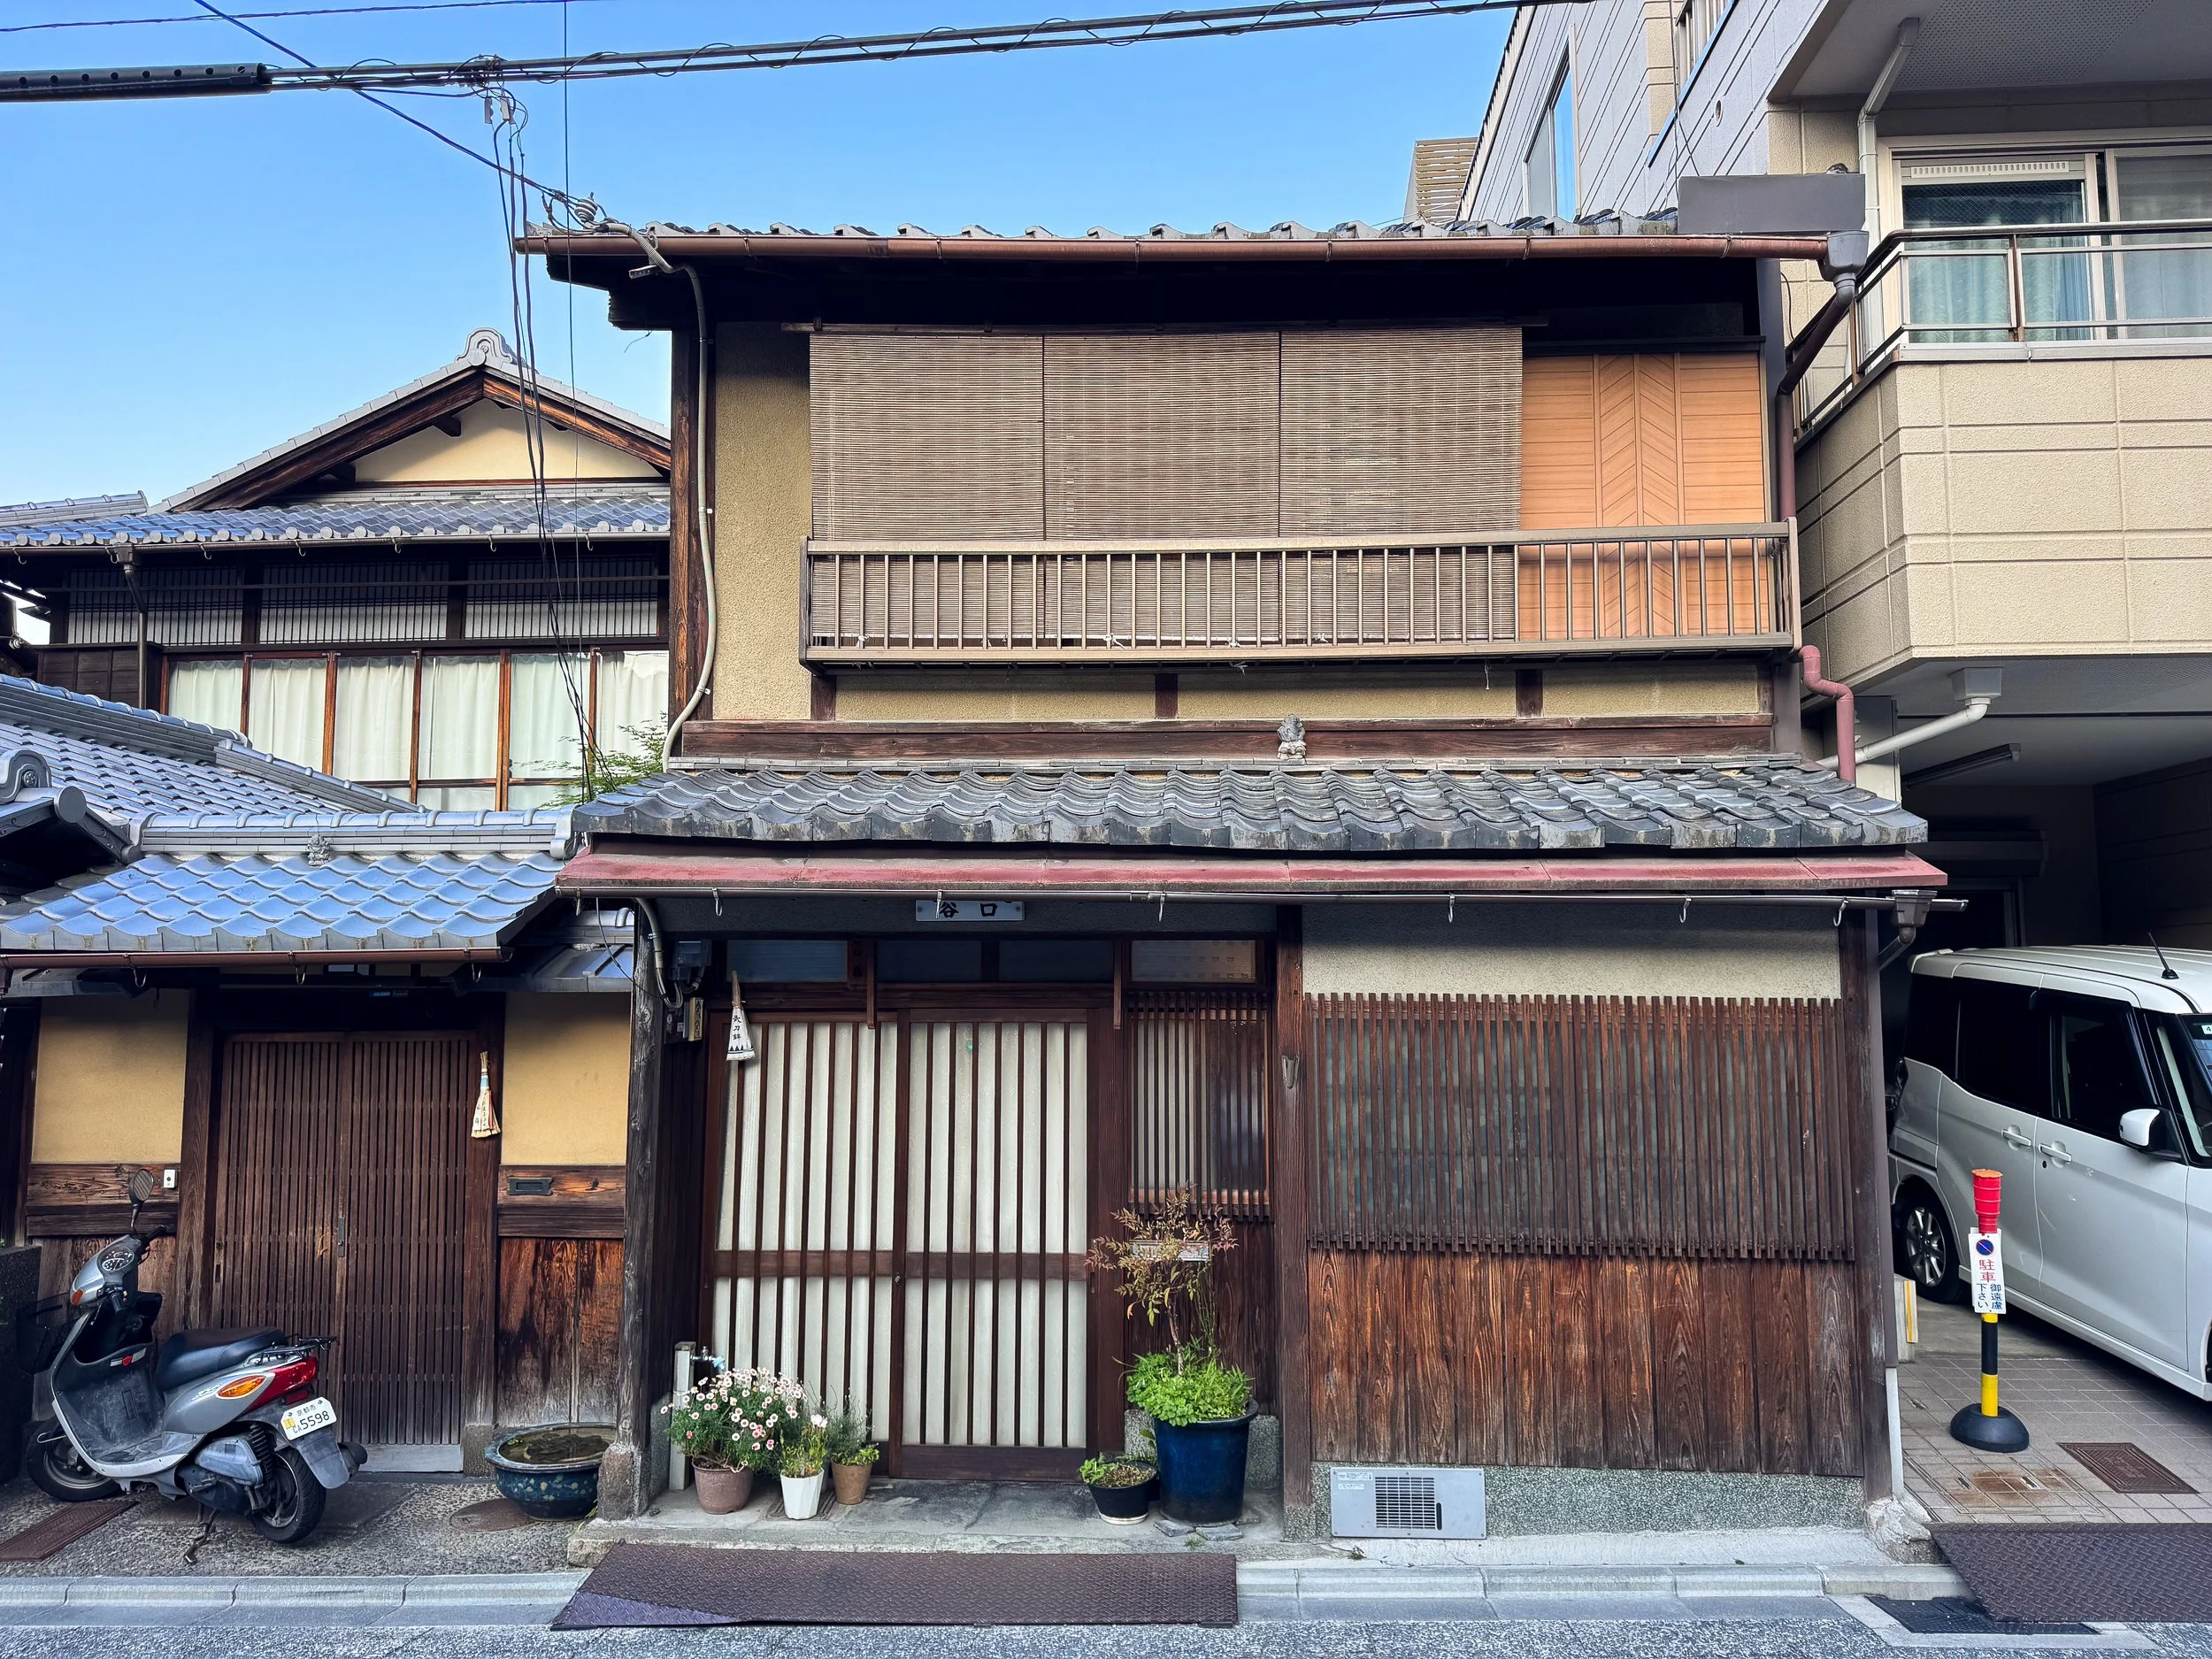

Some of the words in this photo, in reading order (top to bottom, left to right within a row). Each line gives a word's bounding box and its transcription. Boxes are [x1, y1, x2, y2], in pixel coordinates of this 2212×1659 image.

[1979, 1259, 1996, 1282] 駐車
[1976, 1283, 1989, 1308] 下さい
[1990, 1284, 2002, 1310] 御遠慮
[296, 1404, 316, 1417] 京都市
[299, 1410, 330, 1430] 5598
